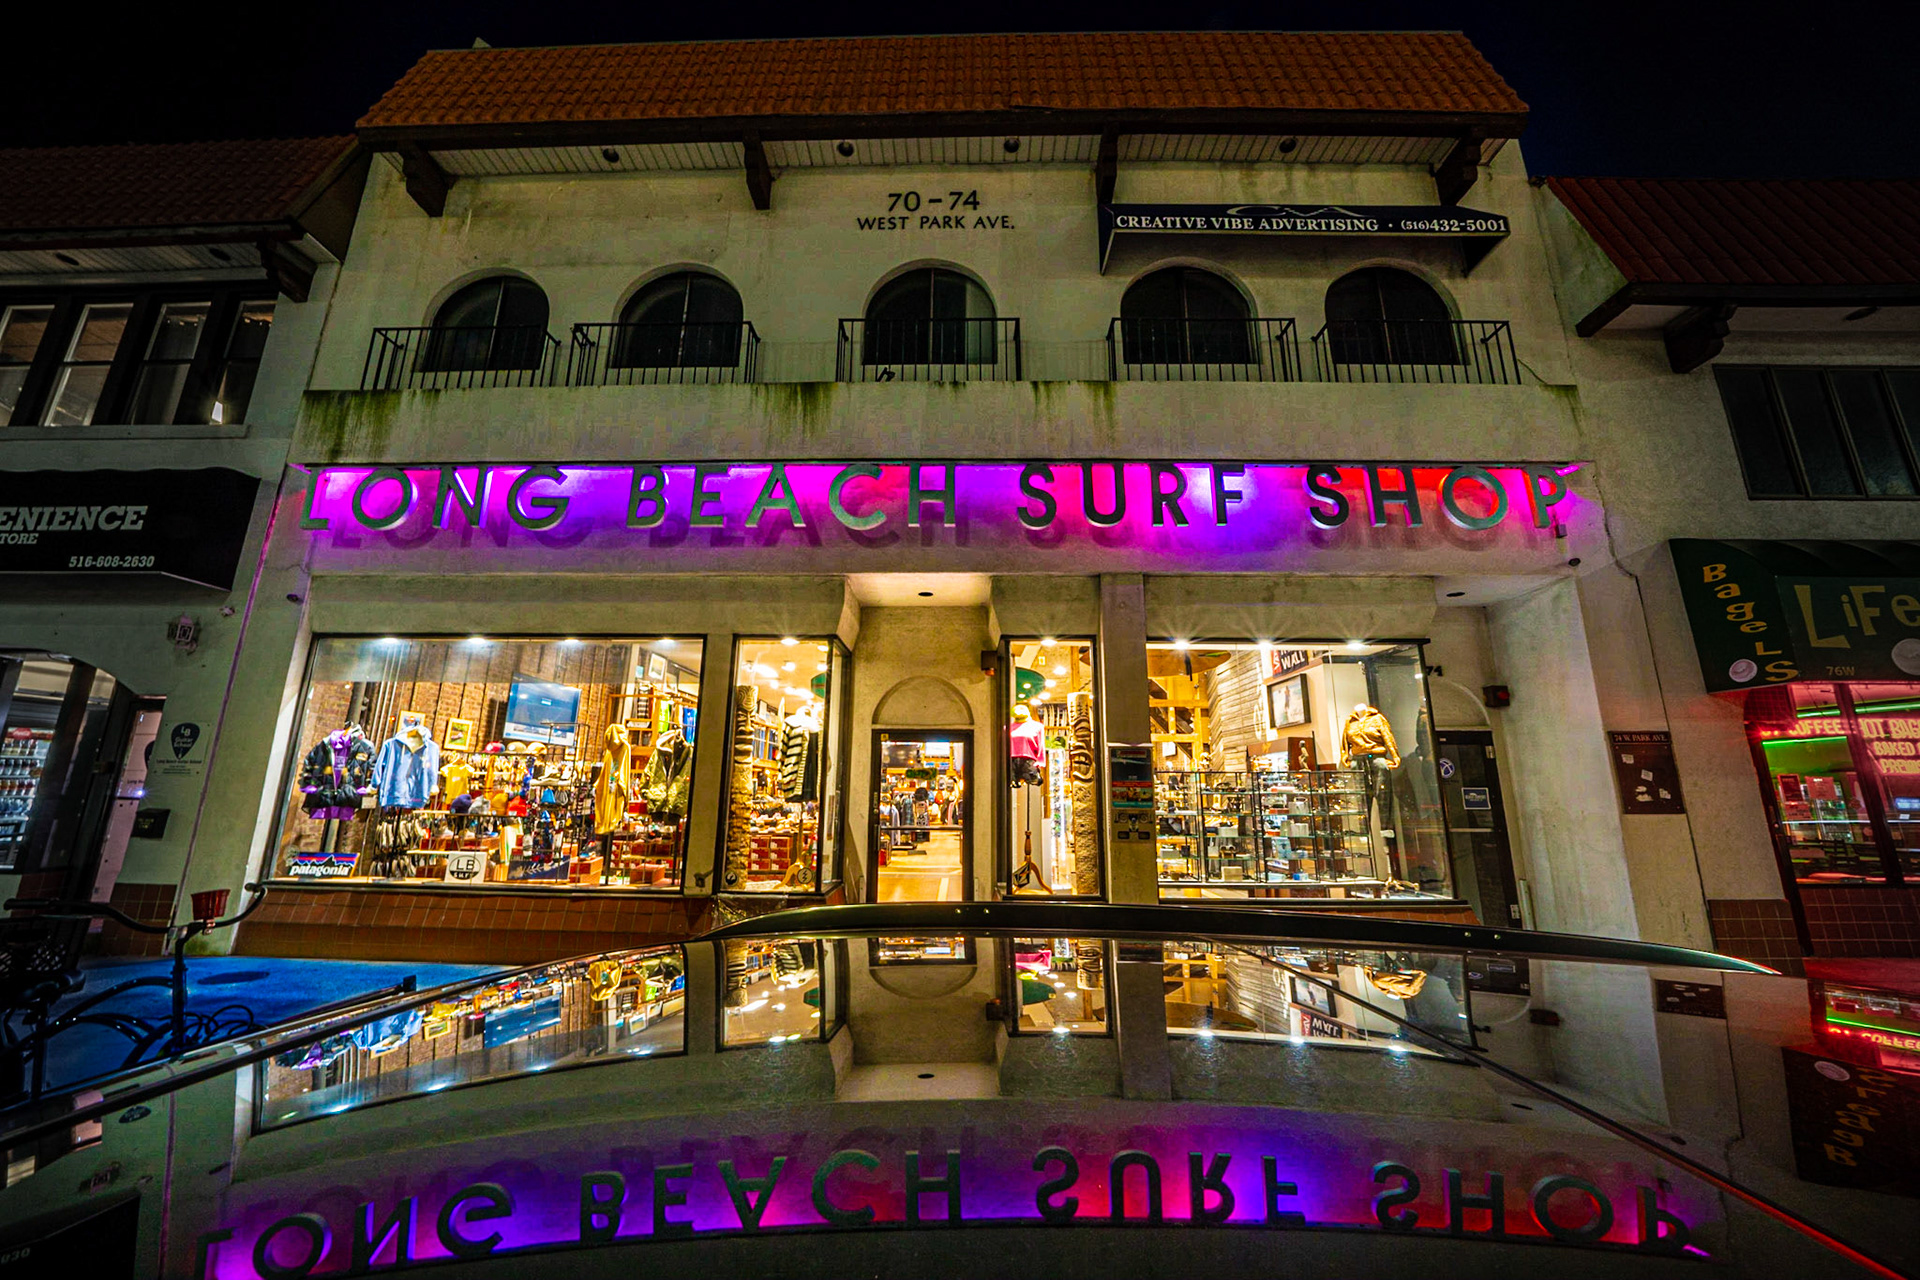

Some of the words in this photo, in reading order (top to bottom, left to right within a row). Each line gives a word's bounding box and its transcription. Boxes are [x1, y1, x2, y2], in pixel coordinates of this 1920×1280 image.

[857, 216, 909, 231] WEST
[919, 215, 965, 230] PARK
[973, 215, 1015, 230] AVE.
[1116, 215, 1207, 229] CREATIVE
[1210, 216, 1254, 230] VIBE
[1258, 217, 1379, 232] ADVERTISING
[1401, 218, 1507, 232] (516)432-5001
[300, 464, 570, 531] LONG
[626, 463, 956, 531] BEACH
[1017, 463, 1247, 528] SURF
[1303, 464, 1567, 531] SHOP
[68, 556, 155, 568] 516-608-2630
[1280, 650, 1306, 670] WALL
[1825, 666, 1856, 677] 76W
[1614, 734, 1622, 742] 74
[1631, 734, 1651, 742] PARK
[1873, 741, 1915, 757] BAKED
[289, 864, 351, 877] patagonia
[456, 859, 475, 871] LB
